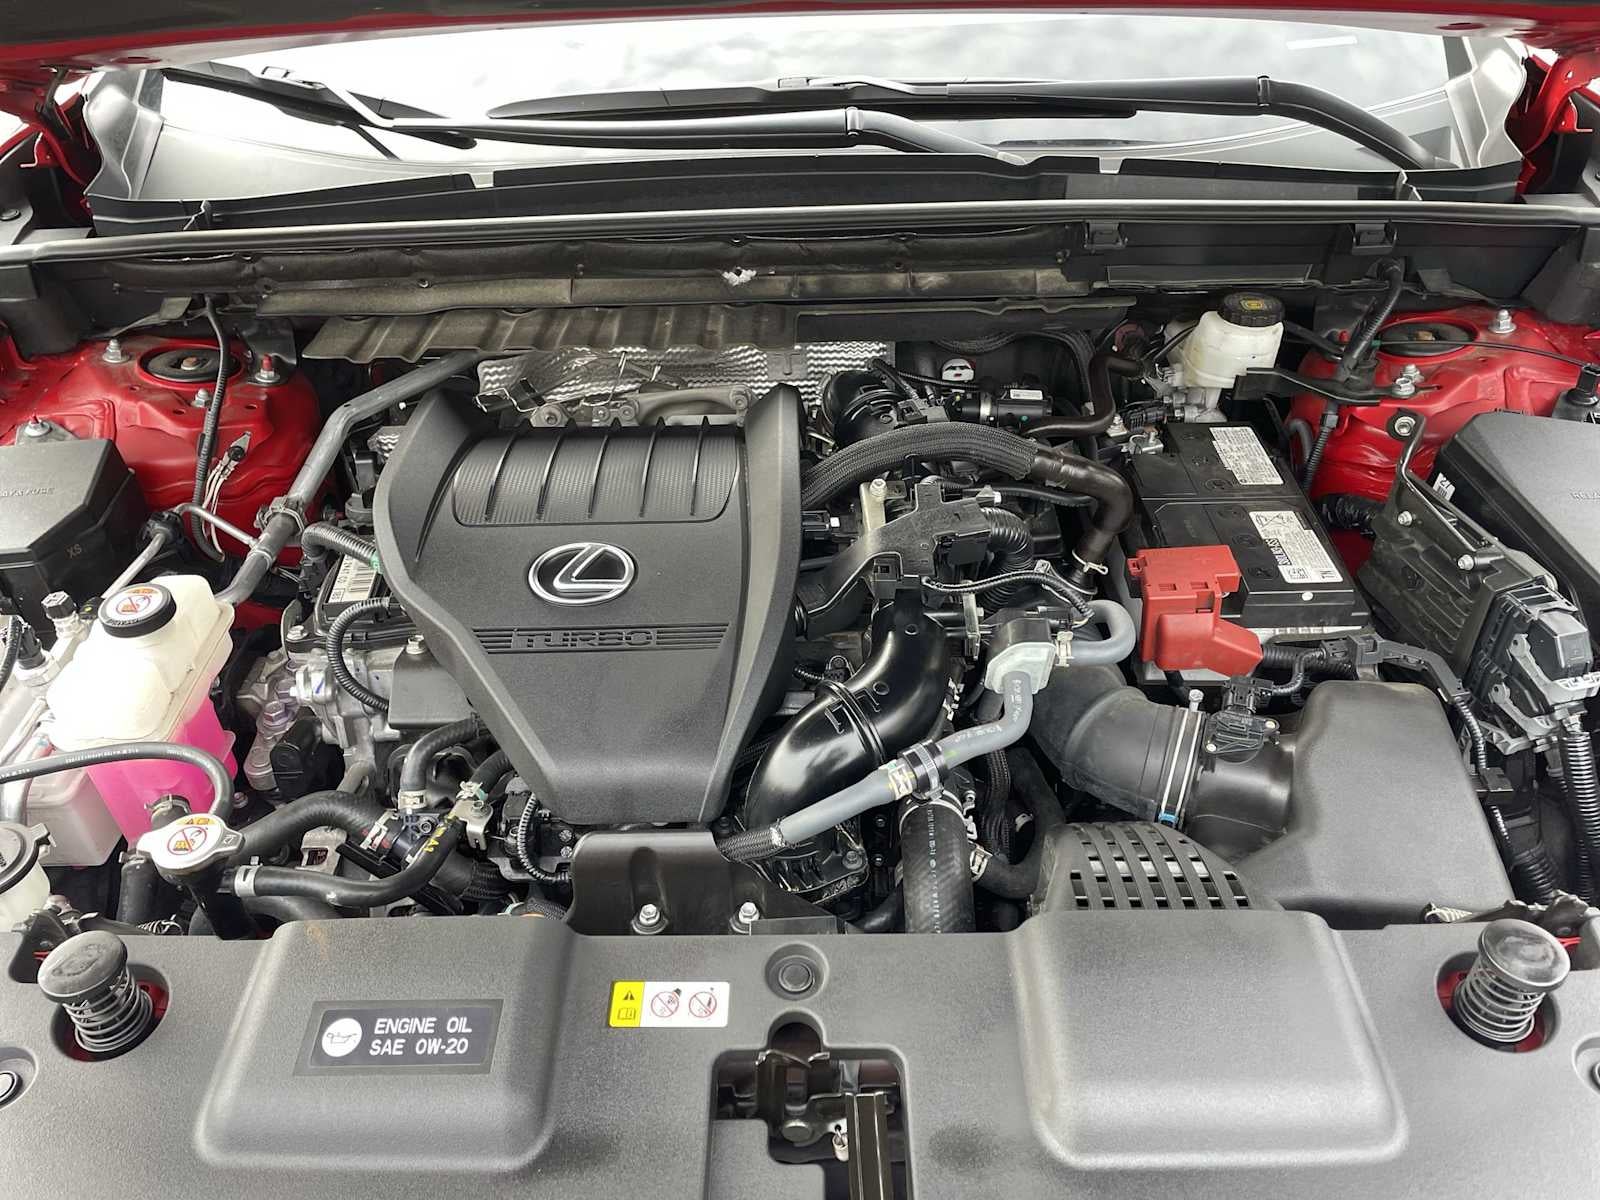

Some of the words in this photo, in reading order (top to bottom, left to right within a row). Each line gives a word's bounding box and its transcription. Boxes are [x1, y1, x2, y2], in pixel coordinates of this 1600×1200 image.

[511, 628, 657, 649] TURBO
[374, 1017, 437, 1034] ENGINE
[446, 1016, 473, 1034] OIL
[369, 1038, 406, 1056] SAE
[415, 1037, 469, 1055] 0W-20
